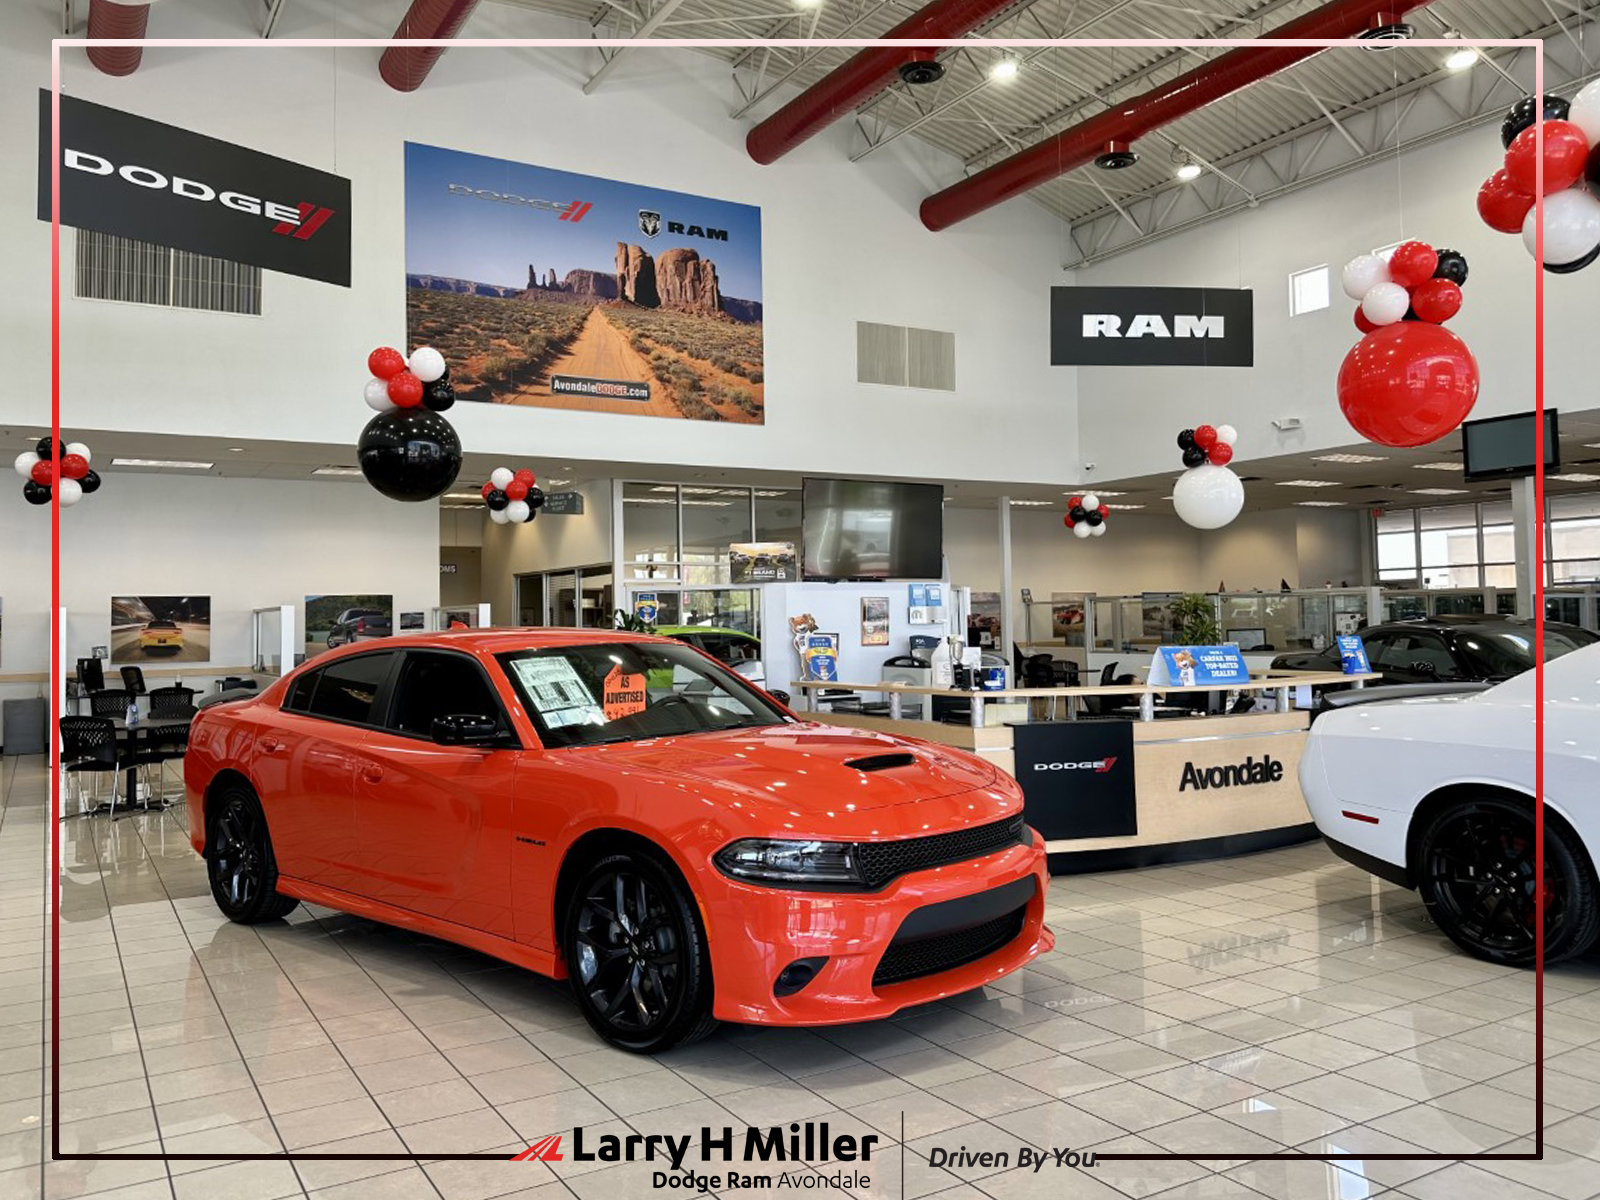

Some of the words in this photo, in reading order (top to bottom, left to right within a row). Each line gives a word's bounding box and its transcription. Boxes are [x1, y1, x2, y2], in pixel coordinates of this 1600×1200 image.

[64, 148, 301, 226] DODGE
[448, 183, 573, 214] DODGE
[667, 221, 729, 242] RAM
[1082, 314, 1225, 339] RAM
[553, 378, 649, 399] AvondaleDODGE.com
[620, 676, 630, 688] AS
[605, 691, 644, 704] ADVERTISED
[1033, 760, 1107, 771] DODGE
[1179, 755, 1283, 792] Avondale
